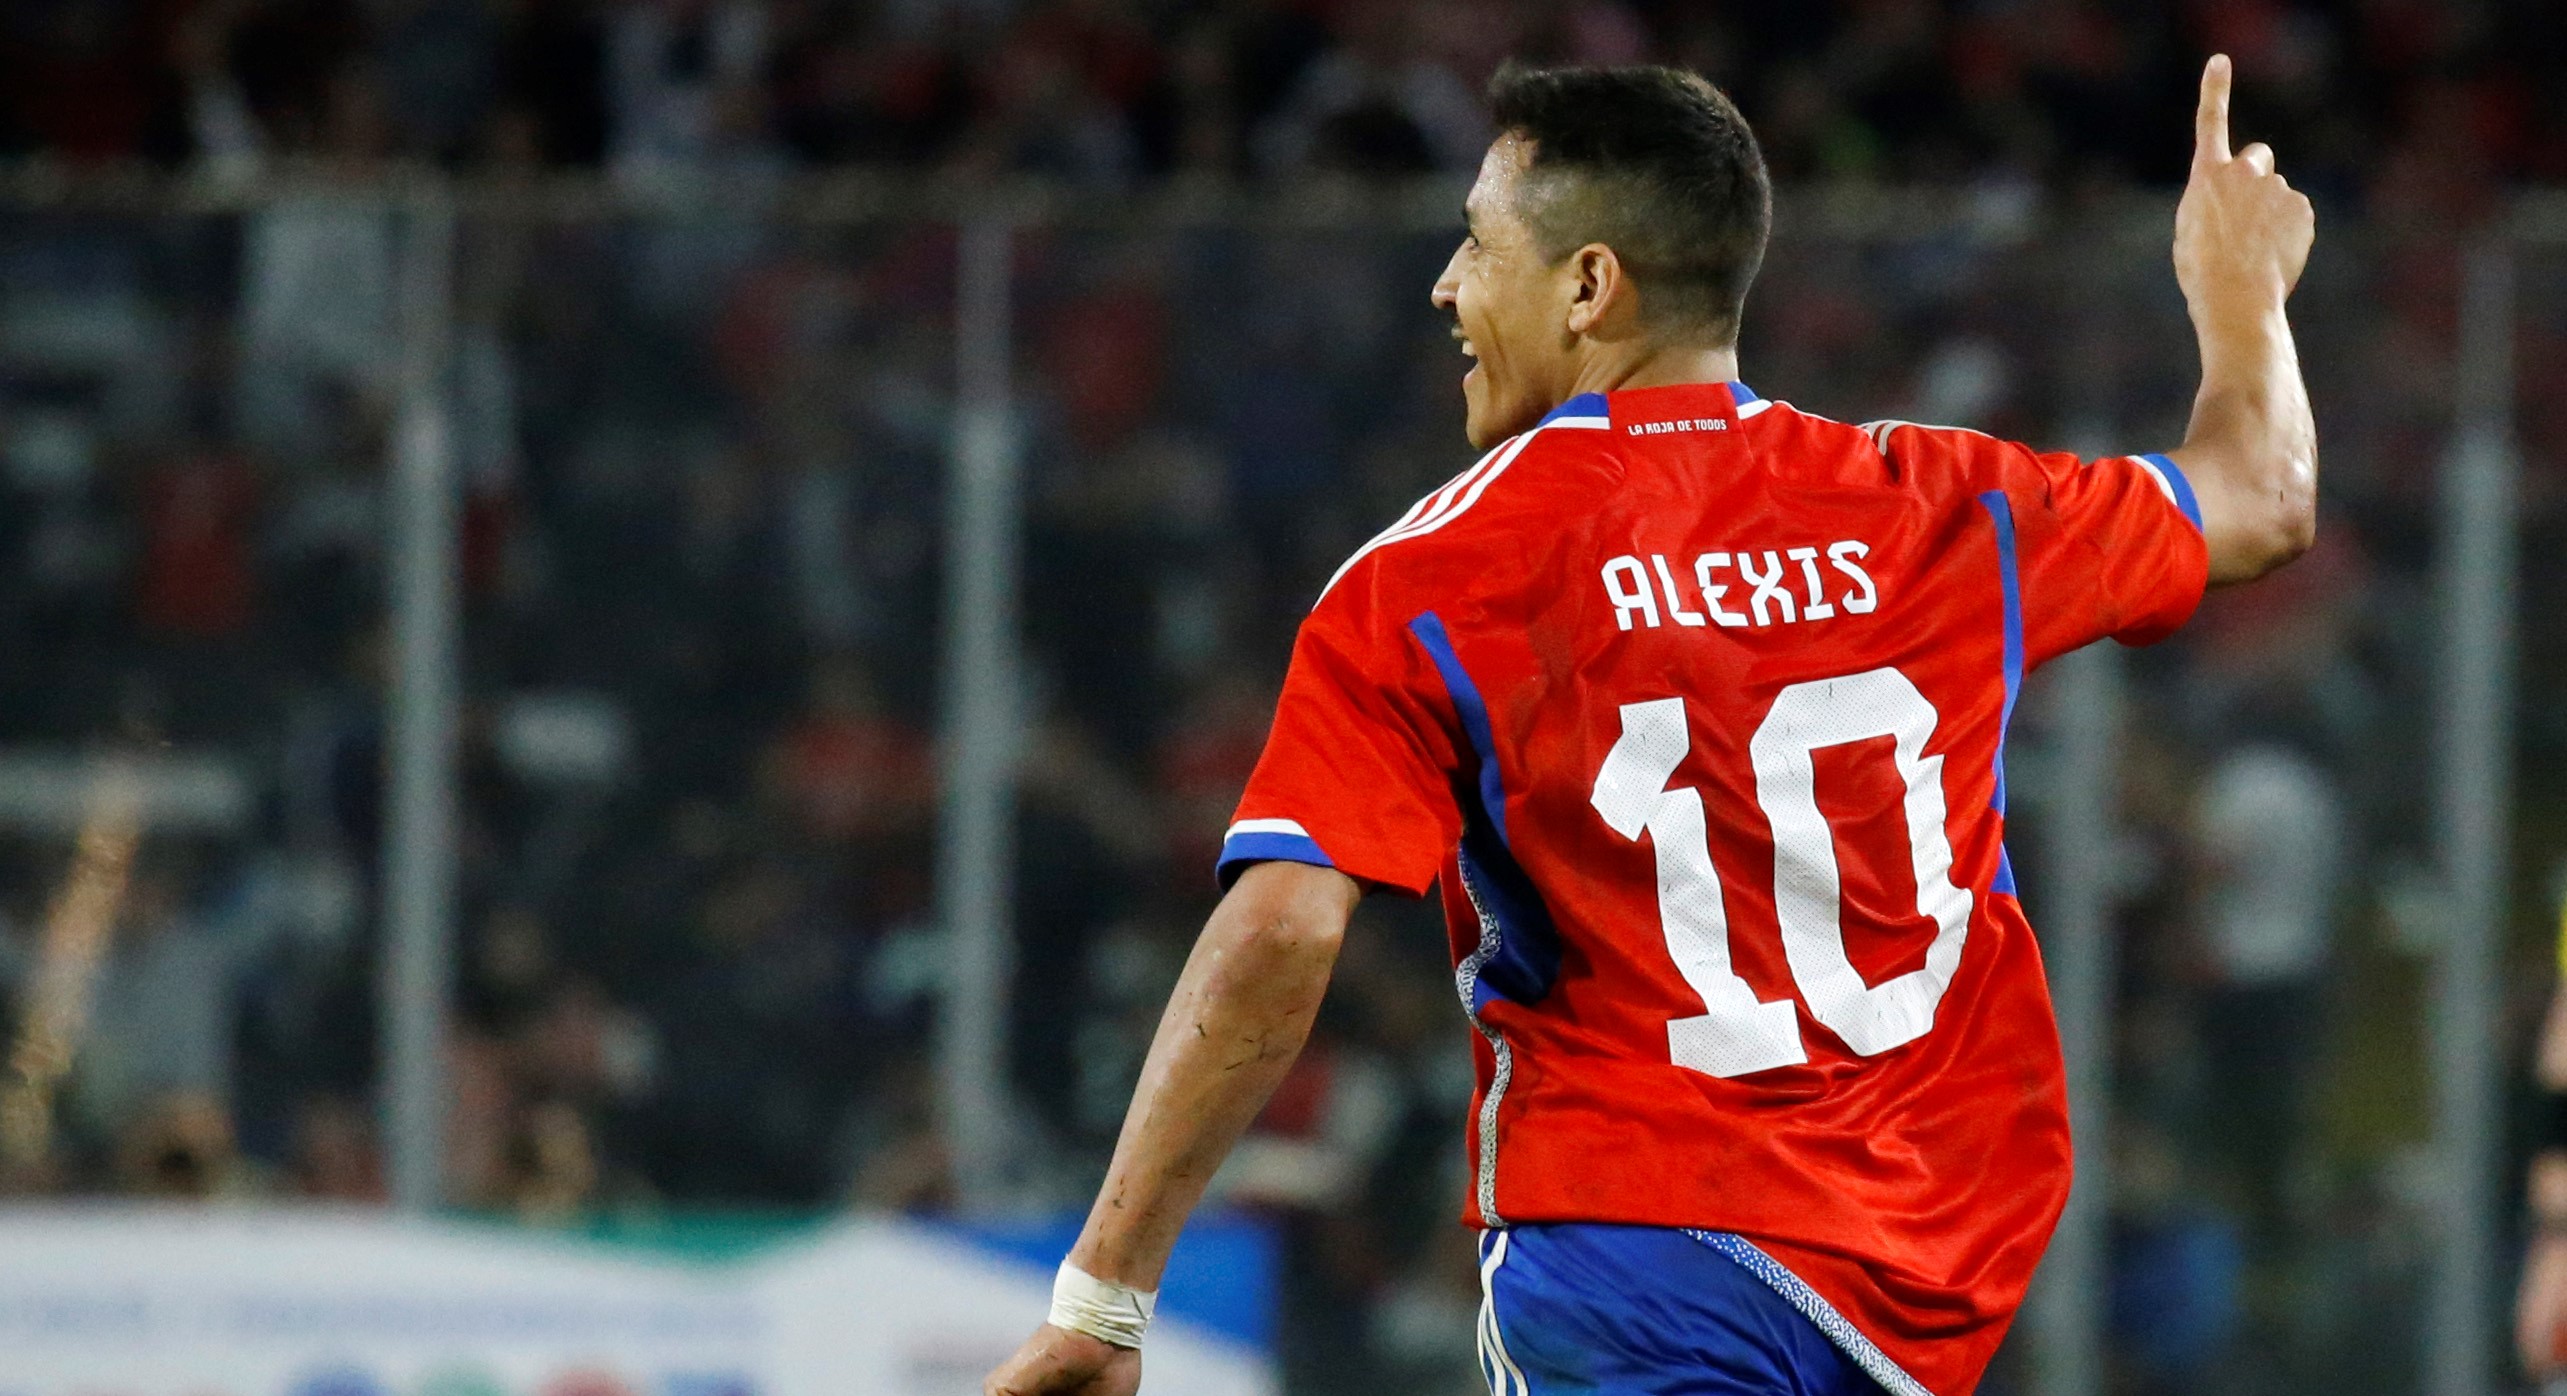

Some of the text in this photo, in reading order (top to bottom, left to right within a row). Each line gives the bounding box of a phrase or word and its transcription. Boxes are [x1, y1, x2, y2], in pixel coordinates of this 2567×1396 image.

[1627, 418, 1728, 436] LA ROJA DE TODOS
[1600, 539, 1879, 632] ALEXIS
[1589, 666, 1974, 1079] 10
